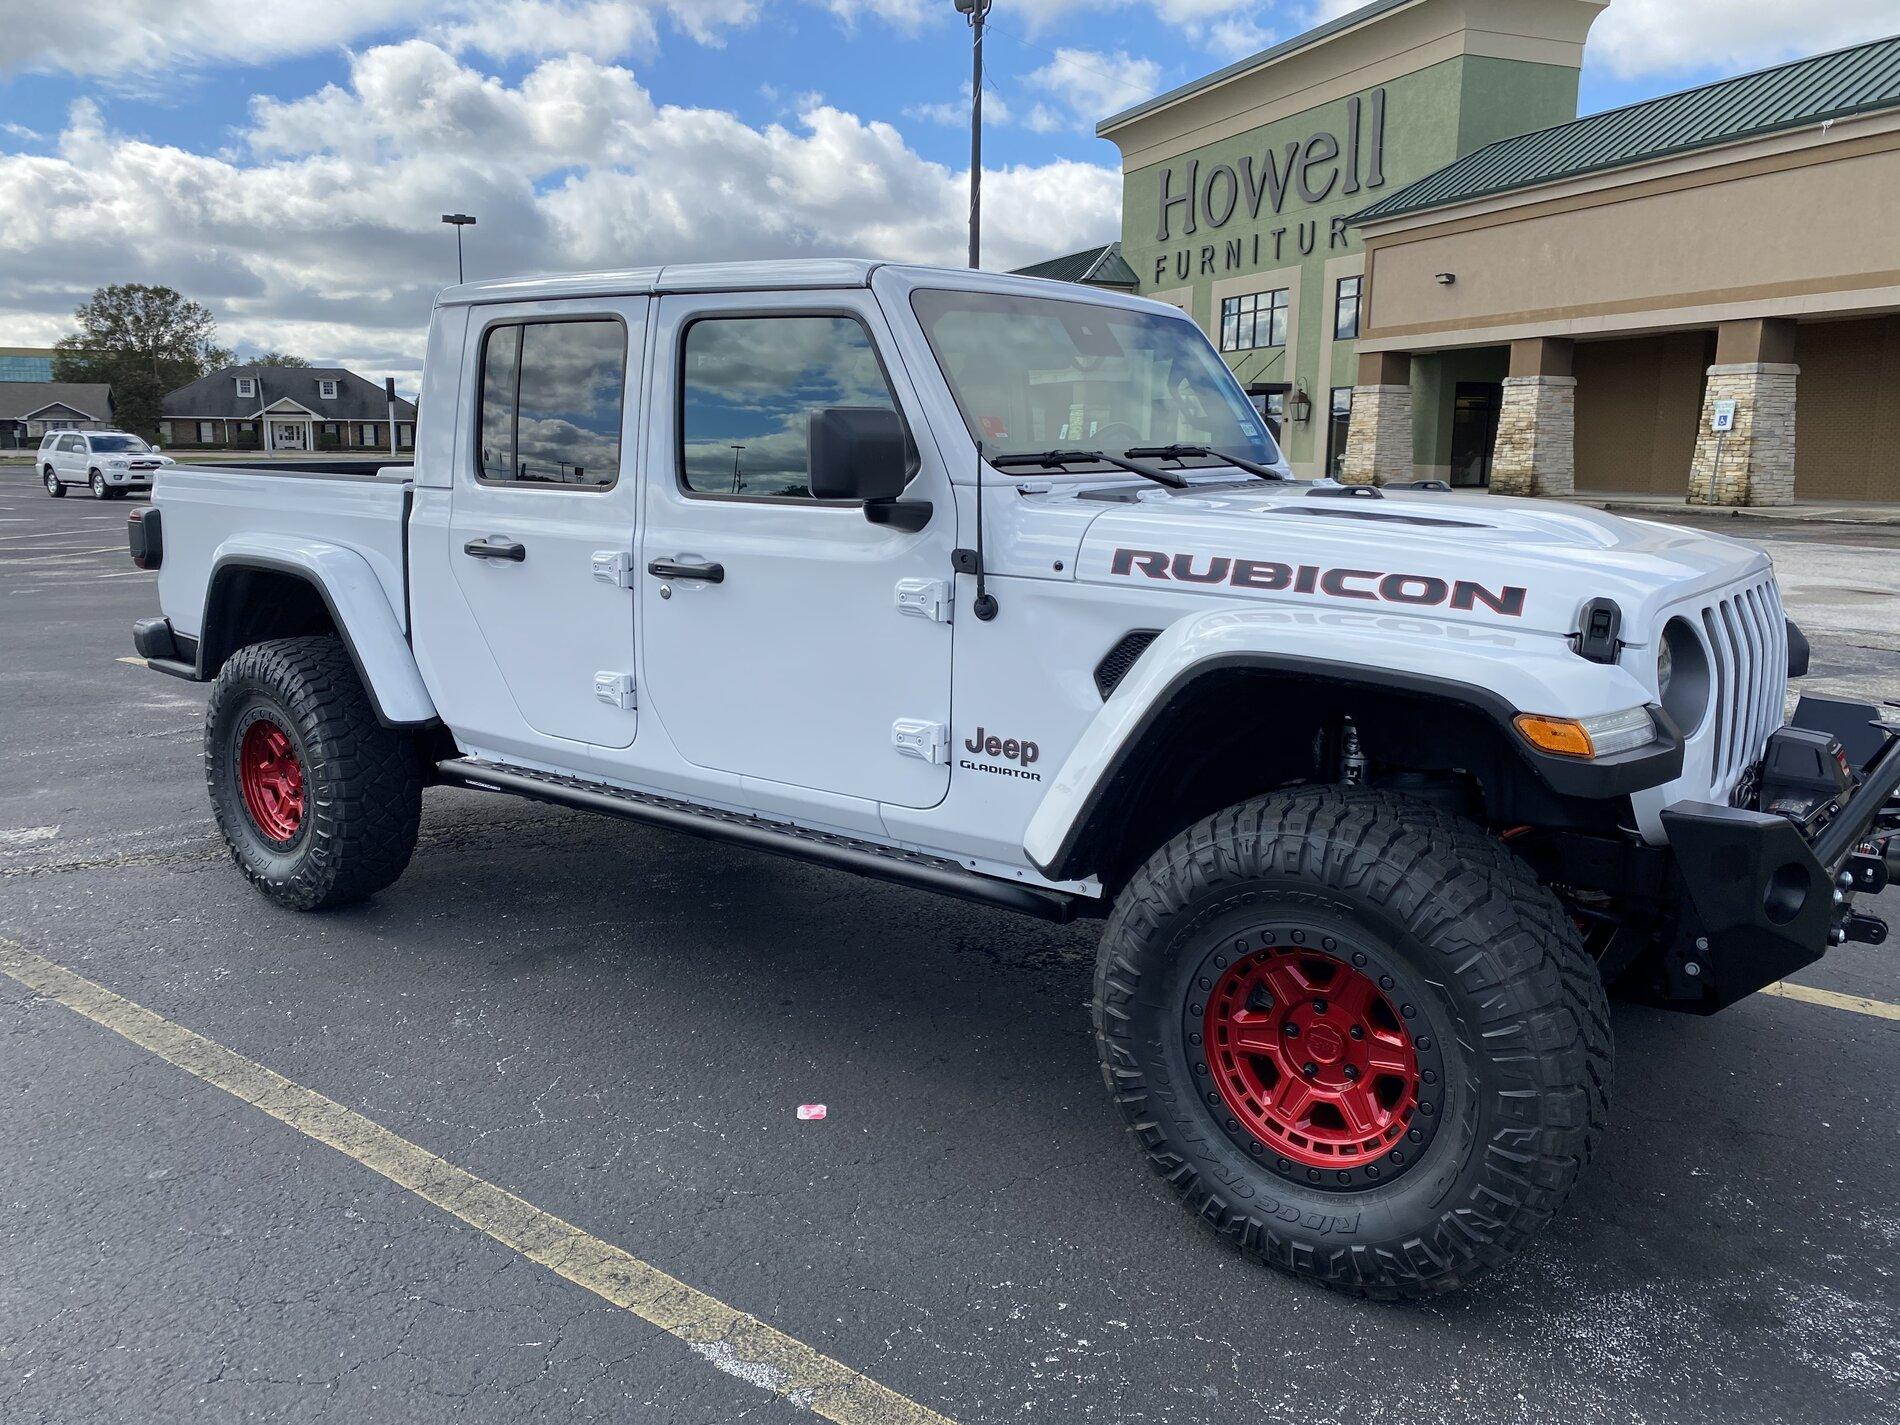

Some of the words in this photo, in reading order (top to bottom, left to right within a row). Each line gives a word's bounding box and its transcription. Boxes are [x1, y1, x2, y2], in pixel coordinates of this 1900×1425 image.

[1156, 87, 1386, 242] Howell
[1155, 213, 1349, 285] FURNITUR
[1110, 548, 1528, 618] RUBICON
[959, 759, 1042, 782] GLADIATOR
[964, 726, 1040, 767] Jeep
[1254, 1195, 1362, 1236] RIDGE
